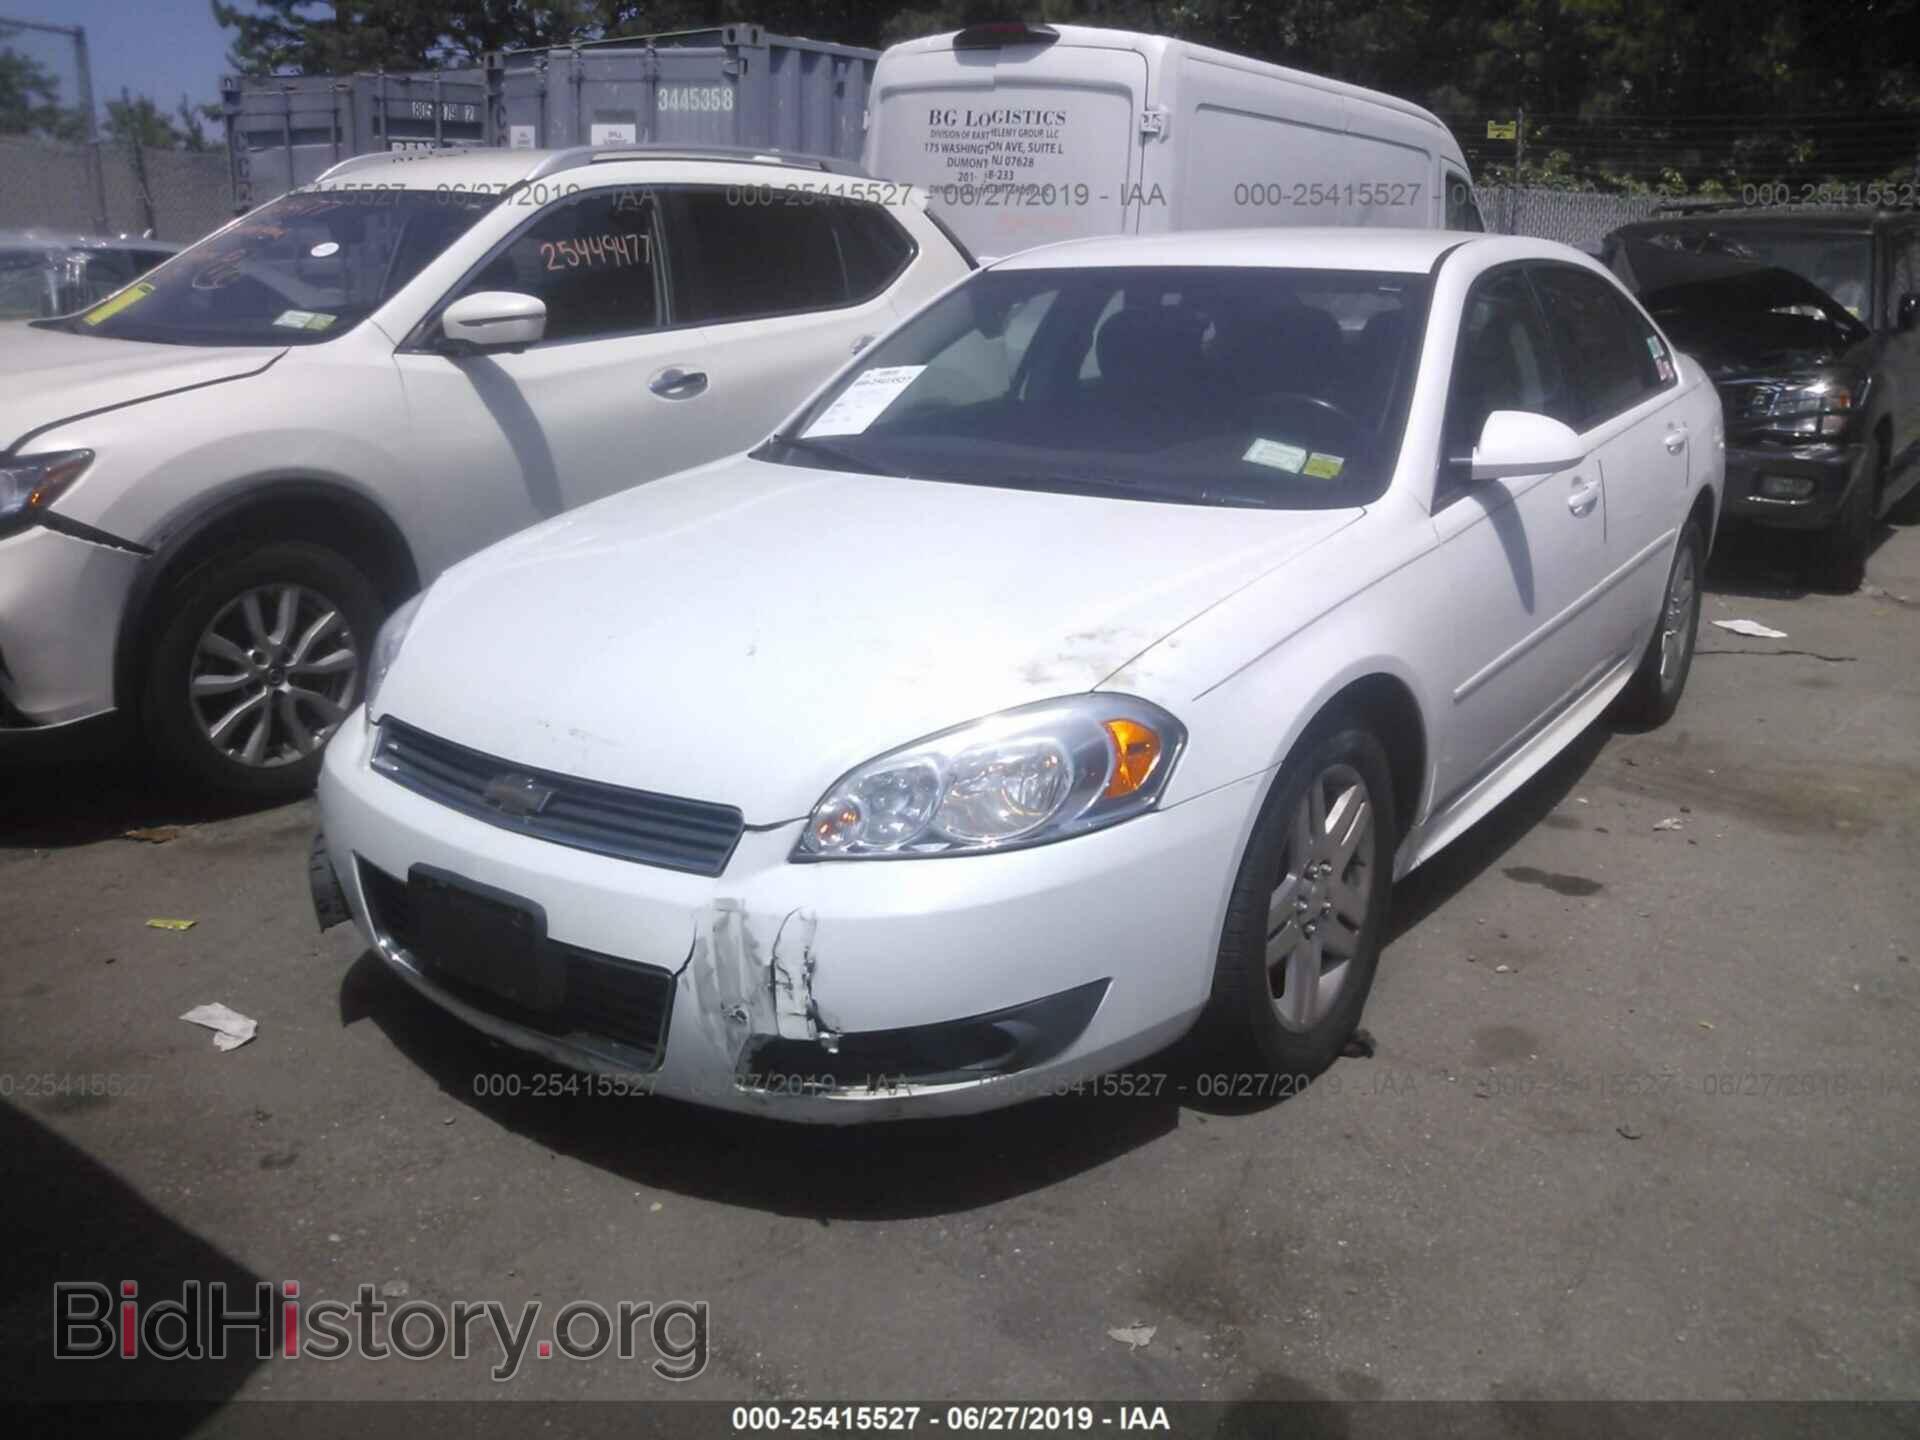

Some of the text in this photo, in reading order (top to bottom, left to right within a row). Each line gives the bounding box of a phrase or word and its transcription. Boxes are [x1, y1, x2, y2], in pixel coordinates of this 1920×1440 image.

[657, 87, 733, 111] 3445358
[928, 109, 1066, 127] BG LOGISTICS
[1028, 143, 1056, 154] SUITE
[946, 157, 988, 169] DUMONT
[540, 234, 650, 270] 25449477
